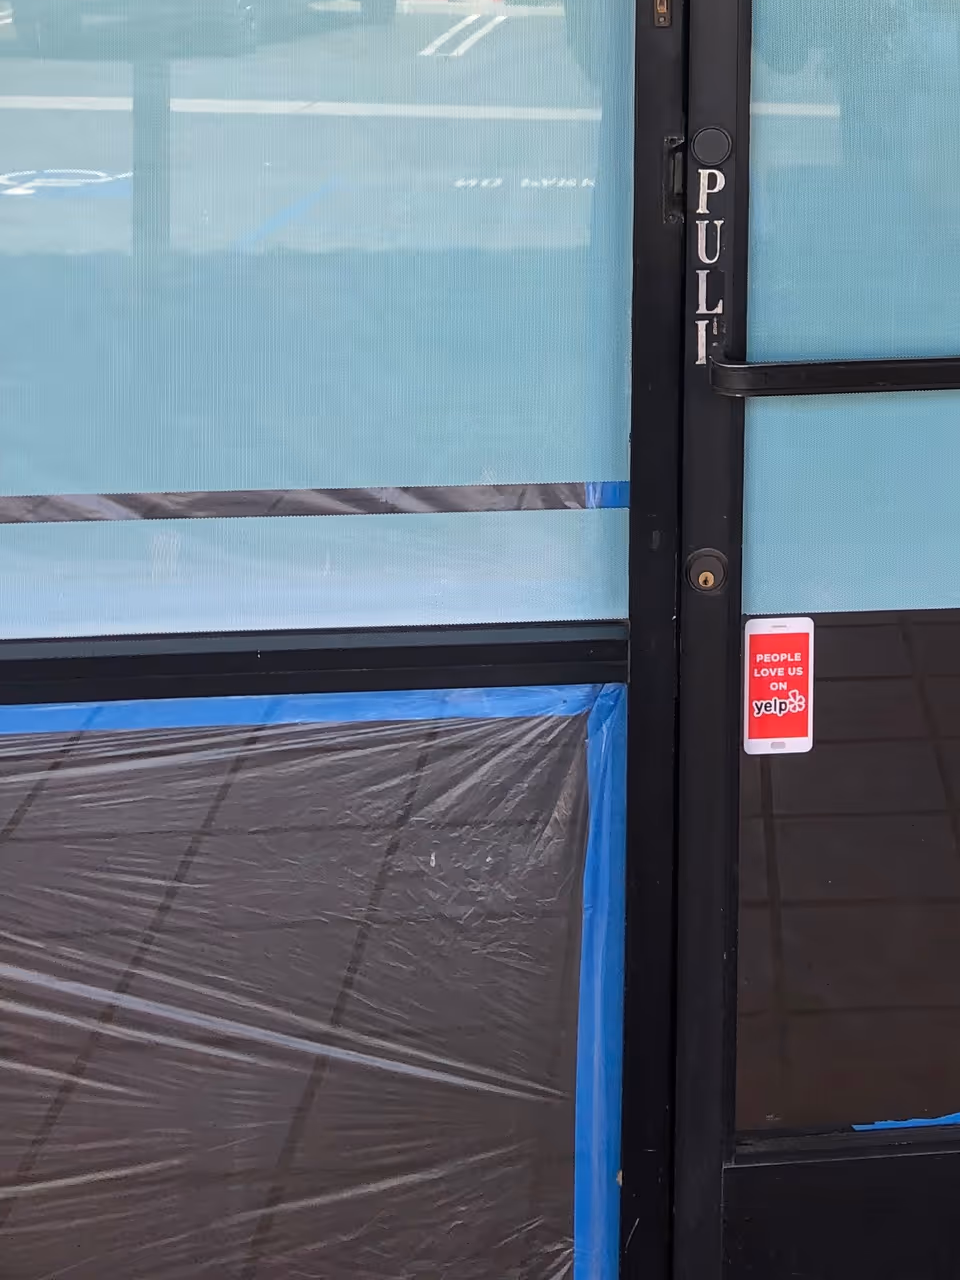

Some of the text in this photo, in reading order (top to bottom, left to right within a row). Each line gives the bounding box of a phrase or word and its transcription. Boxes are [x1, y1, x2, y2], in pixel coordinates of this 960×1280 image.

[755, 652, 802, 663] PEOPLE
[753, 666, 804, 677] LOVE US
[769, 681, 788, 691] ON
[752, 697, 789, 717] yelp
